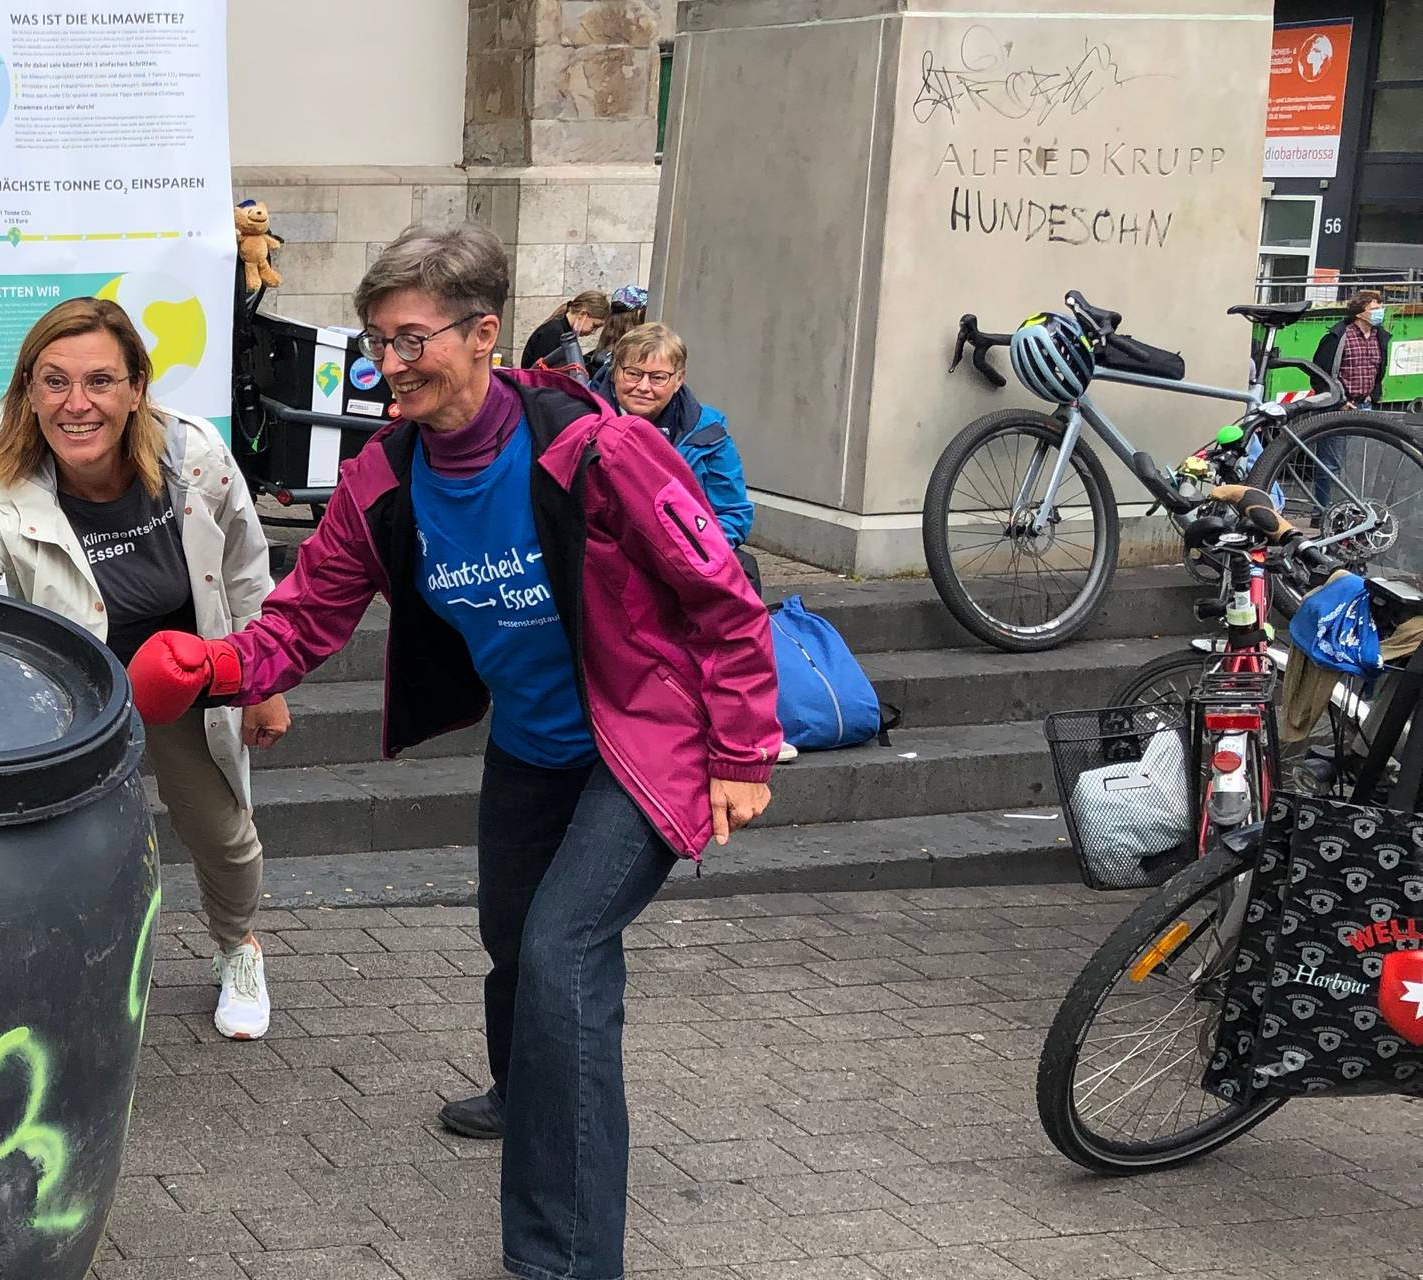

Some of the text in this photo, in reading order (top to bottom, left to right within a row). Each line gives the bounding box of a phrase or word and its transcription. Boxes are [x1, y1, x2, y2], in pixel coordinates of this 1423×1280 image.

[10, 12, 185, 26] WAS IST DIE KLIMAWETTE?
[934, 142, 1226, 177] ALFRED KRUPP
[54, 179, 101, 192] TONNE
[131, 177, 205, 190] EINSPAREN
[950, 186, 1173, 248] HUNDESOHN
[1324, 218, 1342, 234] 56
[36, 285, 60, 297] WIR
[87, 541, 135, 564] Essen
[499, 584, 550, 610] Essen
[1293, 964, 1371, 994] Harbour
